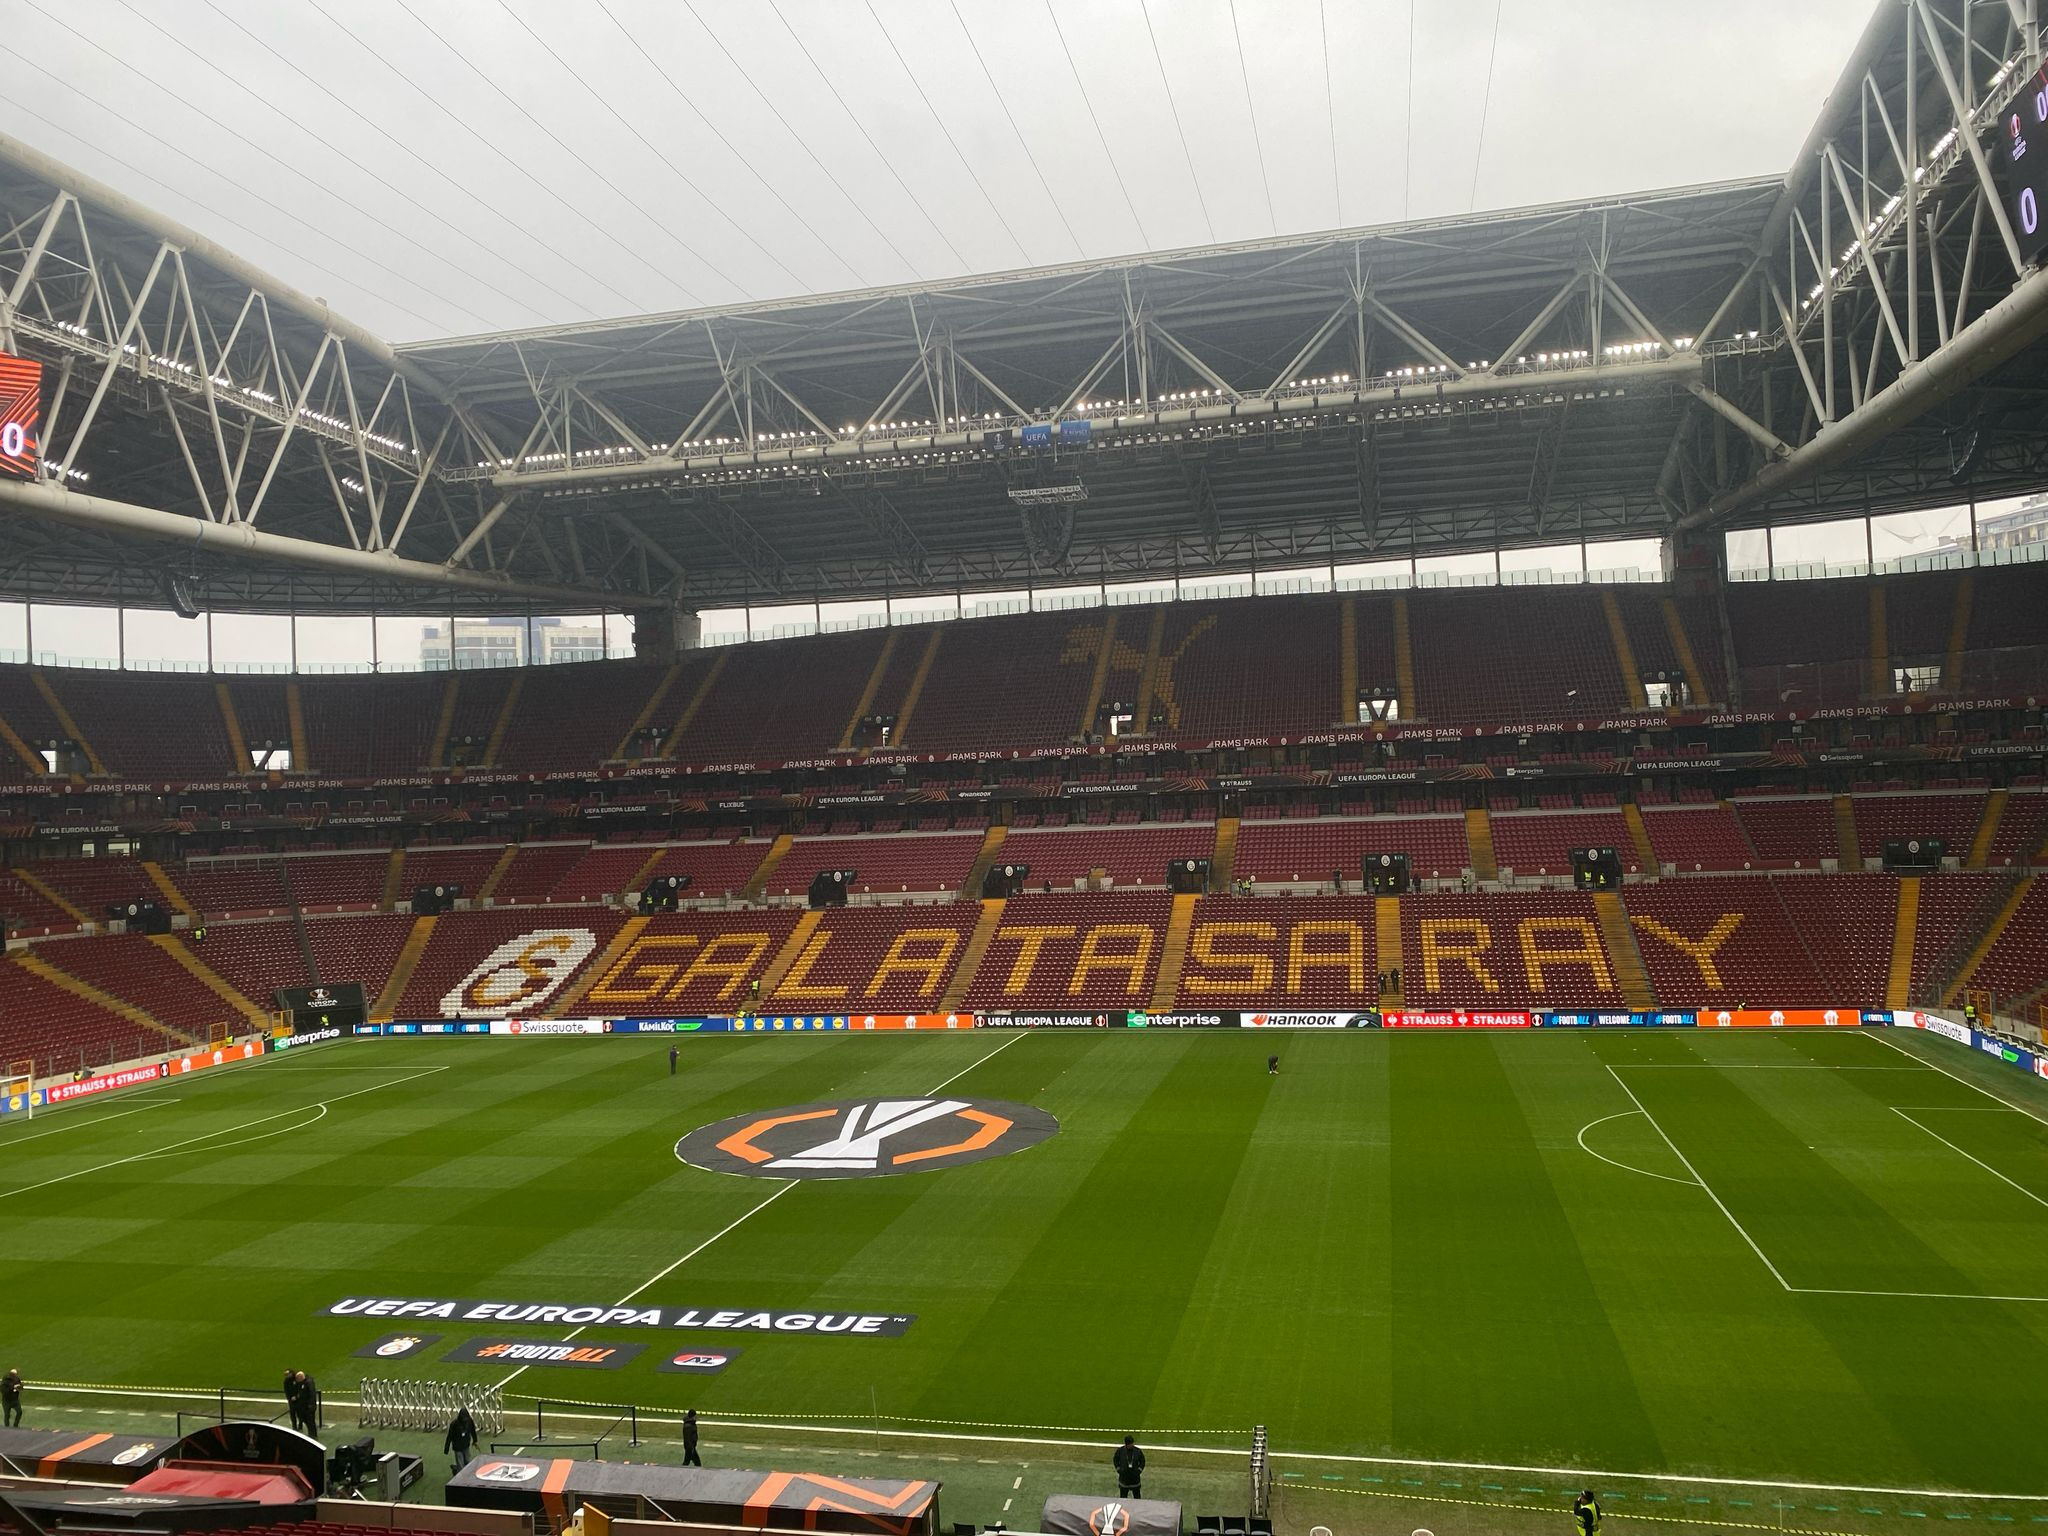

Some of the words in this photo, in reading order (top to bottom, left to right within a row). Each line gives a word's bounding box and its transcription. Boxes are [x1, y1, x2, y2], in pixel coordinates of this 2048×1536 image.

[2021, 187, 2037, 235] 0
[3, 422, 24, 457] 0
[1026, 433, 1047, 442] UEFA
[1938, 702, 1974, 711] RAMS
[1977, 699, 2011, 708] PARK
[1820, 708, 1854, 718] RAMS
[1857, 706, 1889, 715] PARK
[1711, 714, 1742, 723] RAMS
[1745, 712, 1775, 721] PARK
[1504, 725, 1534, 733] RAMS
[1536, 723, 1564, 732] PARK
[1606, 719, 1636, 728] RAMS
[1639, 718, 1668, 726] PARK
[1307, 735, 1336, 743] RAMS
[1338, 733, 1364, 741] PARK
[1404, 730, 1433, 738] RAMS
[1435, 728, 1463, 736] PARK
[1124, 744, 1151, 752] RAMS
[1152, 742, 1177, 750] PARK
[1243, 738, 1269, 746] PARK
[979, 751, 1002, 759] PARK
[1037, 749, 1063, 757] RAMS
[1064, 747, 1089, 755] PARK
[1971, 747, 1995, 755] UEFA
[1997, 745, 2033, 754] EUROPA
[788, 760, 812, 768] RAMS
[814, 759, 836, 767] PARK
[895, 755, 918, 763] PARK
[734, 763, 756, 771] PARK
[1637, 762, 1657, 770] UEFA
[1659, 761, 1689, 769] EUROPA
[1690, 760, 1721, 768] LEAGUE
[630, 768, 653, 776] RAMS
[655, 767, 677, 775] PARK
[1388, 772, 1416, 780] LEAGUE
[409, 777, 434, 785] PARK
[495, 774, 519, 782] PARK
[26, 785, 52, 793] PARK
[93, 784, 122, 792] RAMS
[125, 783, 152, 791] PARK
[192, 783, 221, 791] RAMS
[223, 782, 249, 790] PARK
[318, 780, 344, 788] PARK
[328, 817, 347, 825] UEFA
[348, 816, 376, 824] EUROPA
[377, 815, 402, 823] LEAGUE
[40, 826, 60, 834] UEFA
[61, 826, 90, 834] EUROPA
[90, 825, 119, 833] LEAGUE
[987, 1018, 1013, 1027] UEFA
[1015, 1017, 1053, 1027] EUROPA
[1055, 1016, 1092, 1026] LEAGUE
[1133, 1014, 1221, 1027] enterprise
[1402, 1015, 1453, 1025] STRAUSS
[1473, 1015, 1525, 1025] STRAUSS
[523, 1021, 584, 1034] Swissquote
[1926, 1015, 1962, 1041] Swissquote
[276, 1028, 340, 1048] enterprise
[117, 1067, 156, 1085] STRAUSS
[62, 1079, 105, 1098] STRAUSS
[330, 1299, 456, 1318] UEFA
[462, 1303, 661, 1326] EUROPA
[674, 1310, 889, 1333] LEAGUE
[476, 1343, 616, 1363] #FOOTBALL
[682, 1356, 714, 1365] AZ
[482, 1464, 525, 1479] AZ
